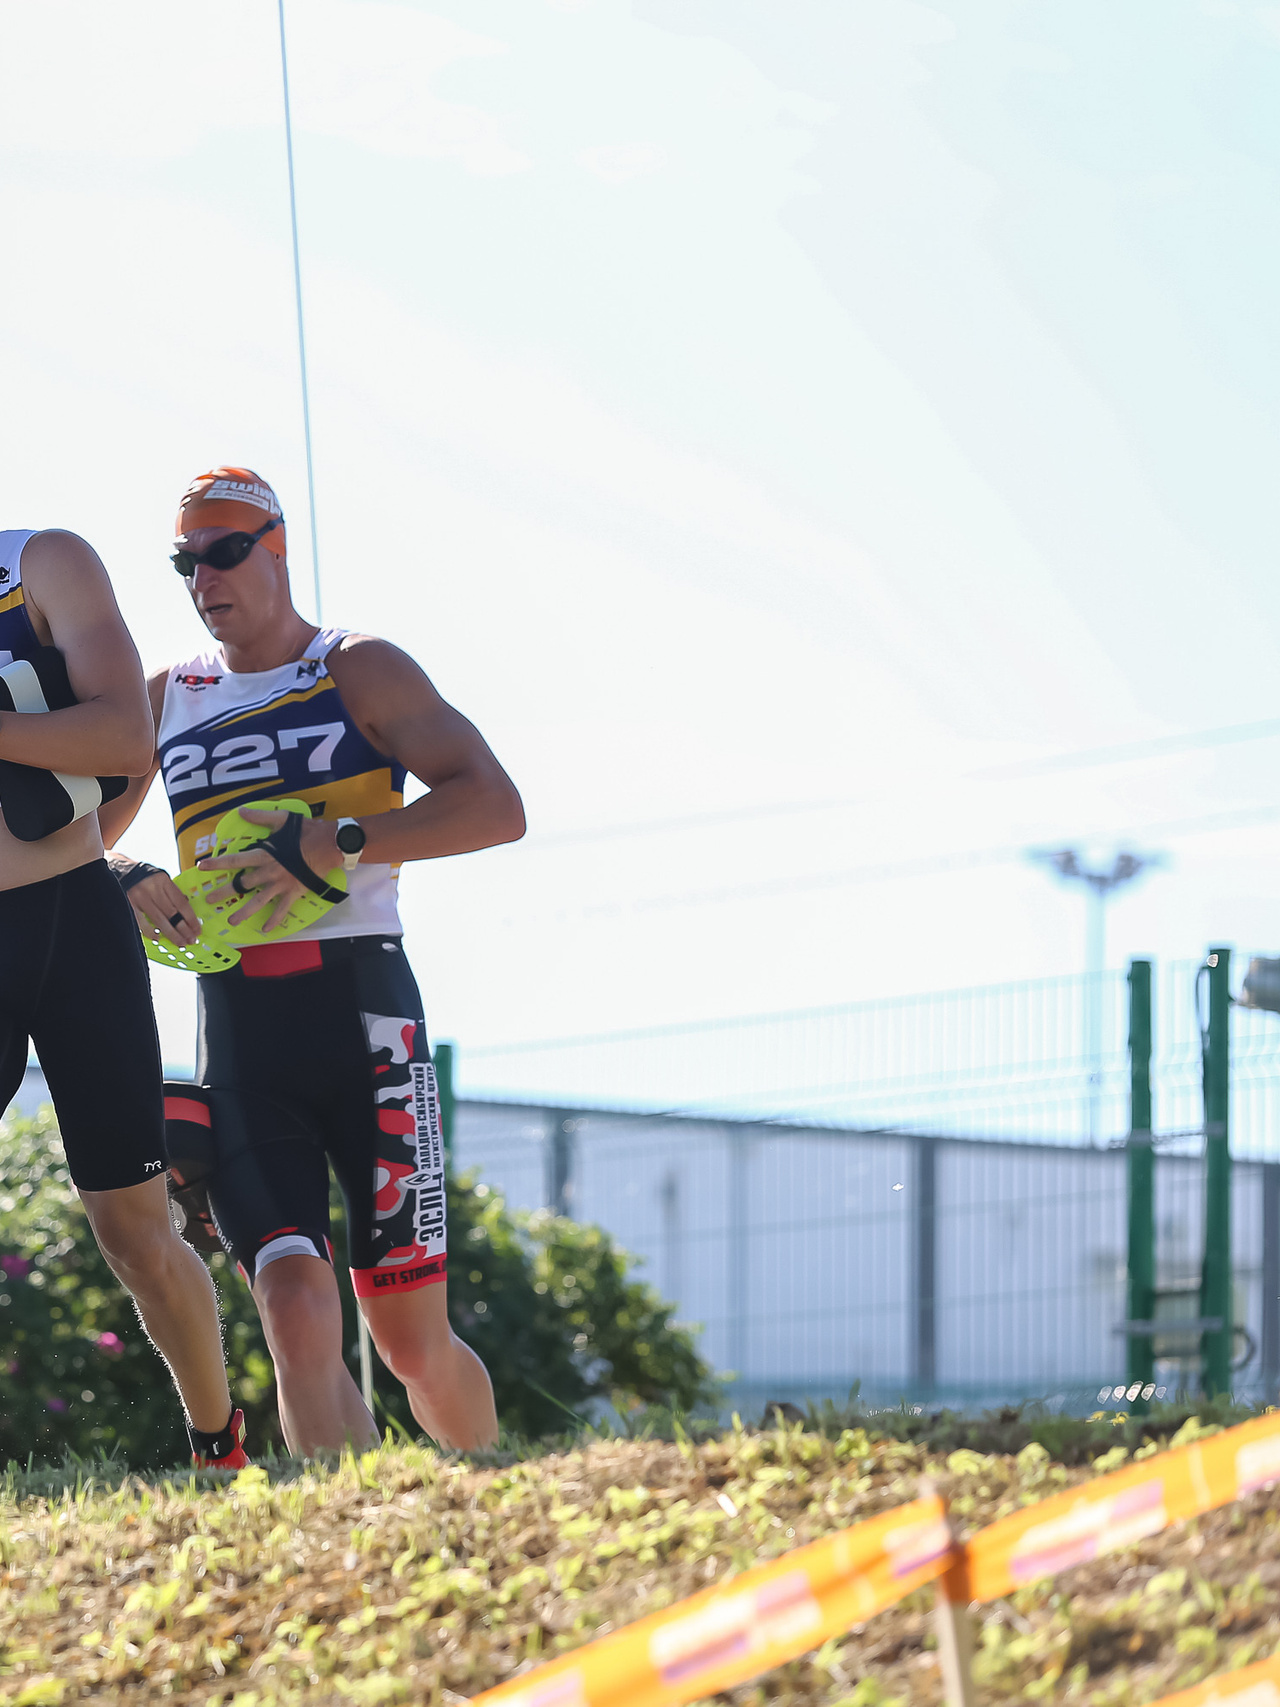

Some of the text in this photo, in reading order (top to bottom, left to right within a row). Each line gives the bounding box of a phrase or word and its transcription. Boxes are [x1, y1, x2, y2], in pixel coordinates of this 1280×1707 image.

[163, 721, 346, 797] 227
[413, 1066, 431, 1170] ЗАПАДНО-СИБИРСКИЙ
[144, 1160, 162, 1173] TYR
[372, 1272, 397, 1288] GET
